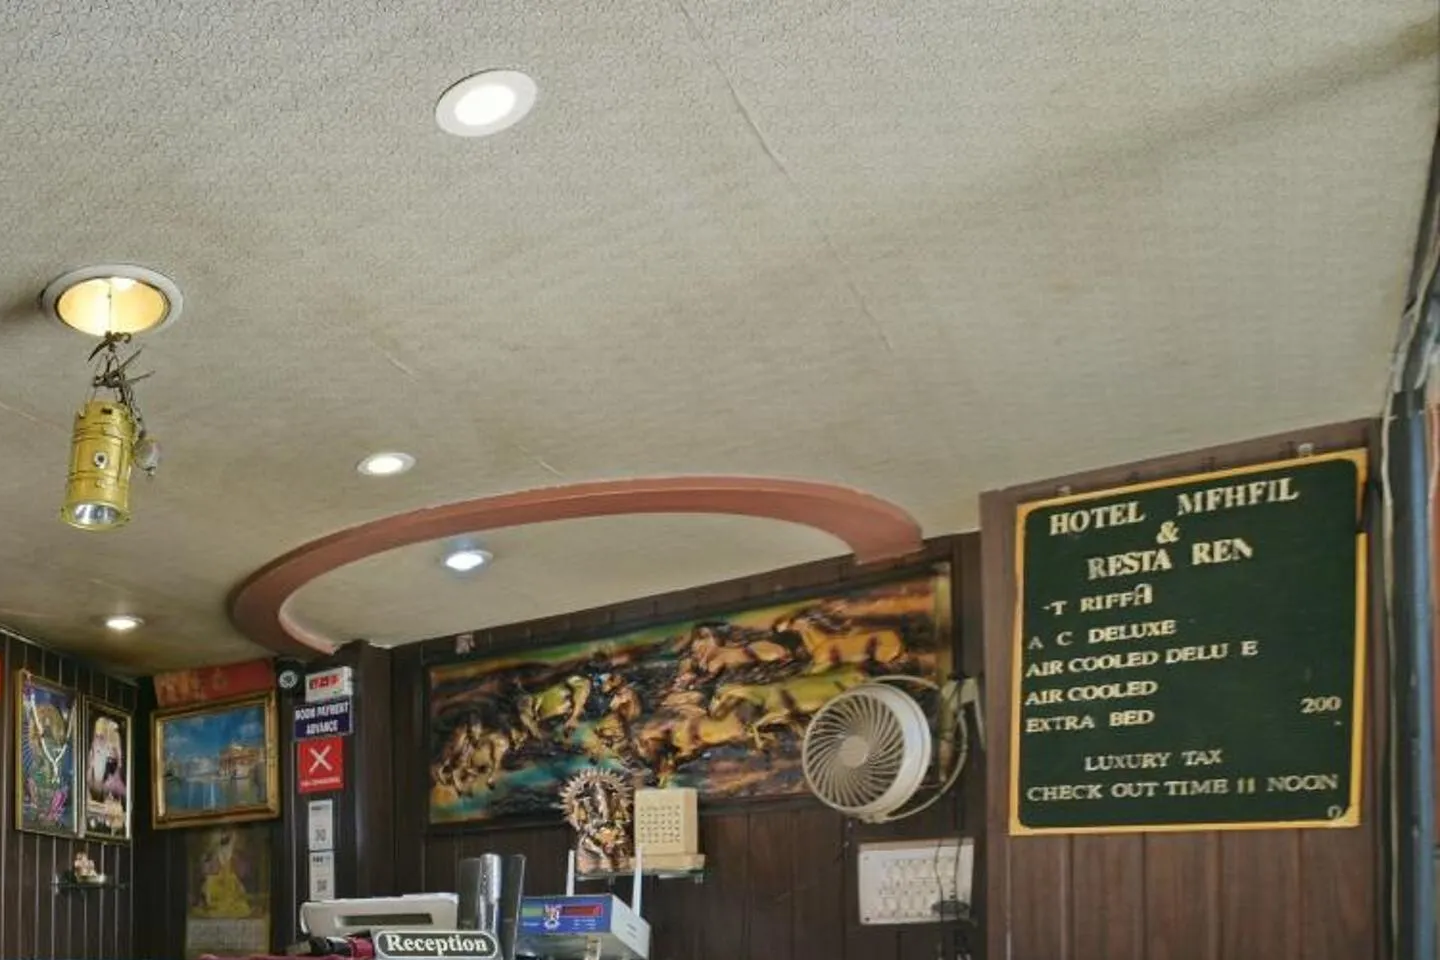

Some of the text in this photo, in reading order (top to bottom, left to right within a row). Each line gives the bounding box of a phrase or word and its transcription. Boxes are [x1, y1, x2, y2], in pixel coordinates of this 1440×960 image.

[1049, 501, 1147, 536] HOTEL
[1156, 520, 1181, 544] &
[1086, 549, 1173, 580] RESTA
[1087, 619, 1178, 645] DELUXE
[1025, 660, 1064, 678] AIR
[1067, 650, 1160, 673] COOLED
[1025, 680, 1159, 706] AIR COOLED
[1300, 696, 1343, 714] 200
[1025, 709, 1156, 733] EXTRA BED
[1084, 749, 1224, 772] LUXURY TAX
[1026, 784, 1104, 801] CHECK
[1111, 781, 1160, 798] OUT
[1163, 778, 1230, 797] TIME
[1265, 773, 1340, 793] NOON
[385, 934, 489, 957] Reception
